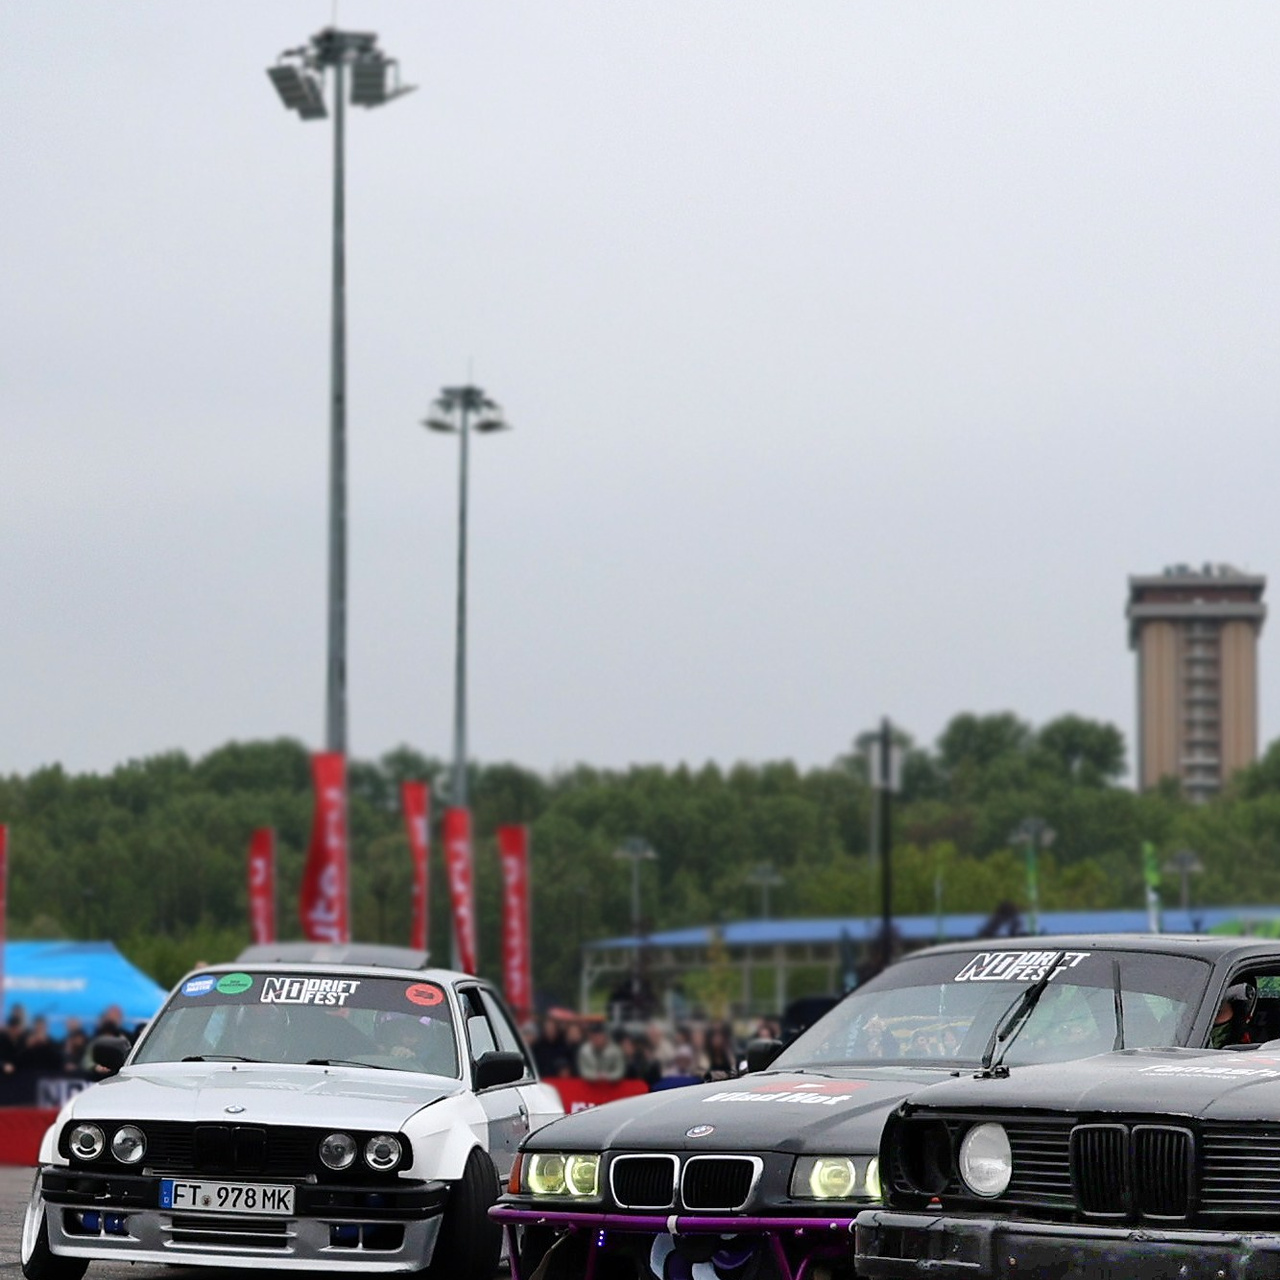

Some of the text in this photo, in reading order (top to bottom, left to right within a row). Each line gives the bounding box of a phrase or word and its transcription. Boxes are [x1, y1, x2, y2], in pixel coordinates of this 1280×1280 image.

[1018, 951, 1092, 967] DRIFT
[1004, 965, 1068, 981] FEST
[307, 978, 361, 994] DRIFT
[303, 991, 351, 1006] FEST
[173, 1184, 202, 1206] FT
[217, 1186, 257, 1208] 978
[261, 1188, 291, 1211] MK
